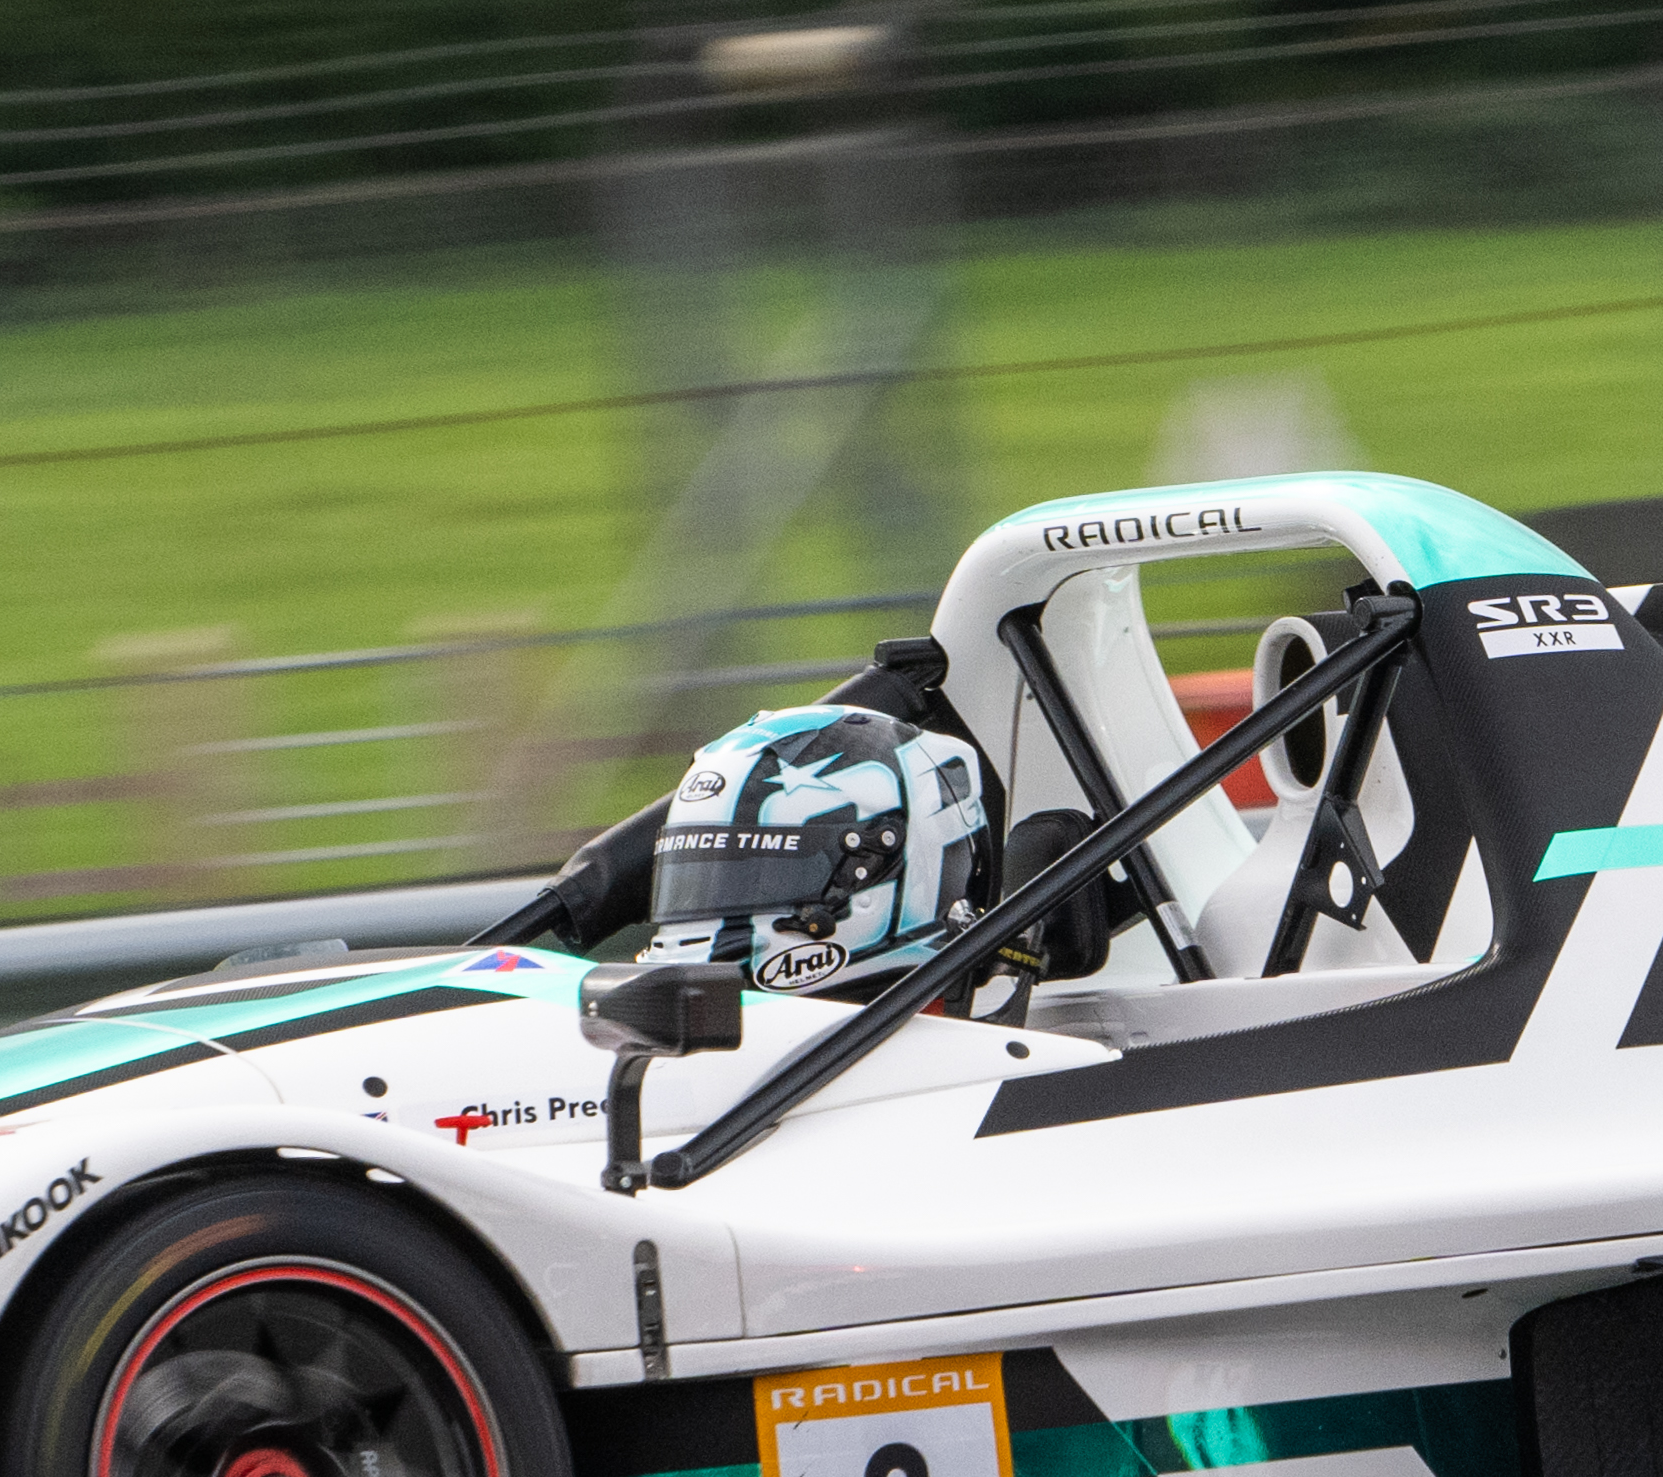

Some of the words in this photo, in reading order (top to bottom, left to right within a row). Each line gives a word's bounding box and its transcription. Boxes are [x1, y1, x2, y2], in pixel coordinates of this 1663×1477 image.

[1042, 507, 1262, 553] RADICAL
[1468, 594, 1610, 629] SR3
[1532, 631, 1578, 648] XXR
[737, 833, 801, 851] TIME
[766, 944, 836, 985] Arai
[461, 1101, 538, 1129] Chris
[770, 1369, 990, 1411] RADICAL
